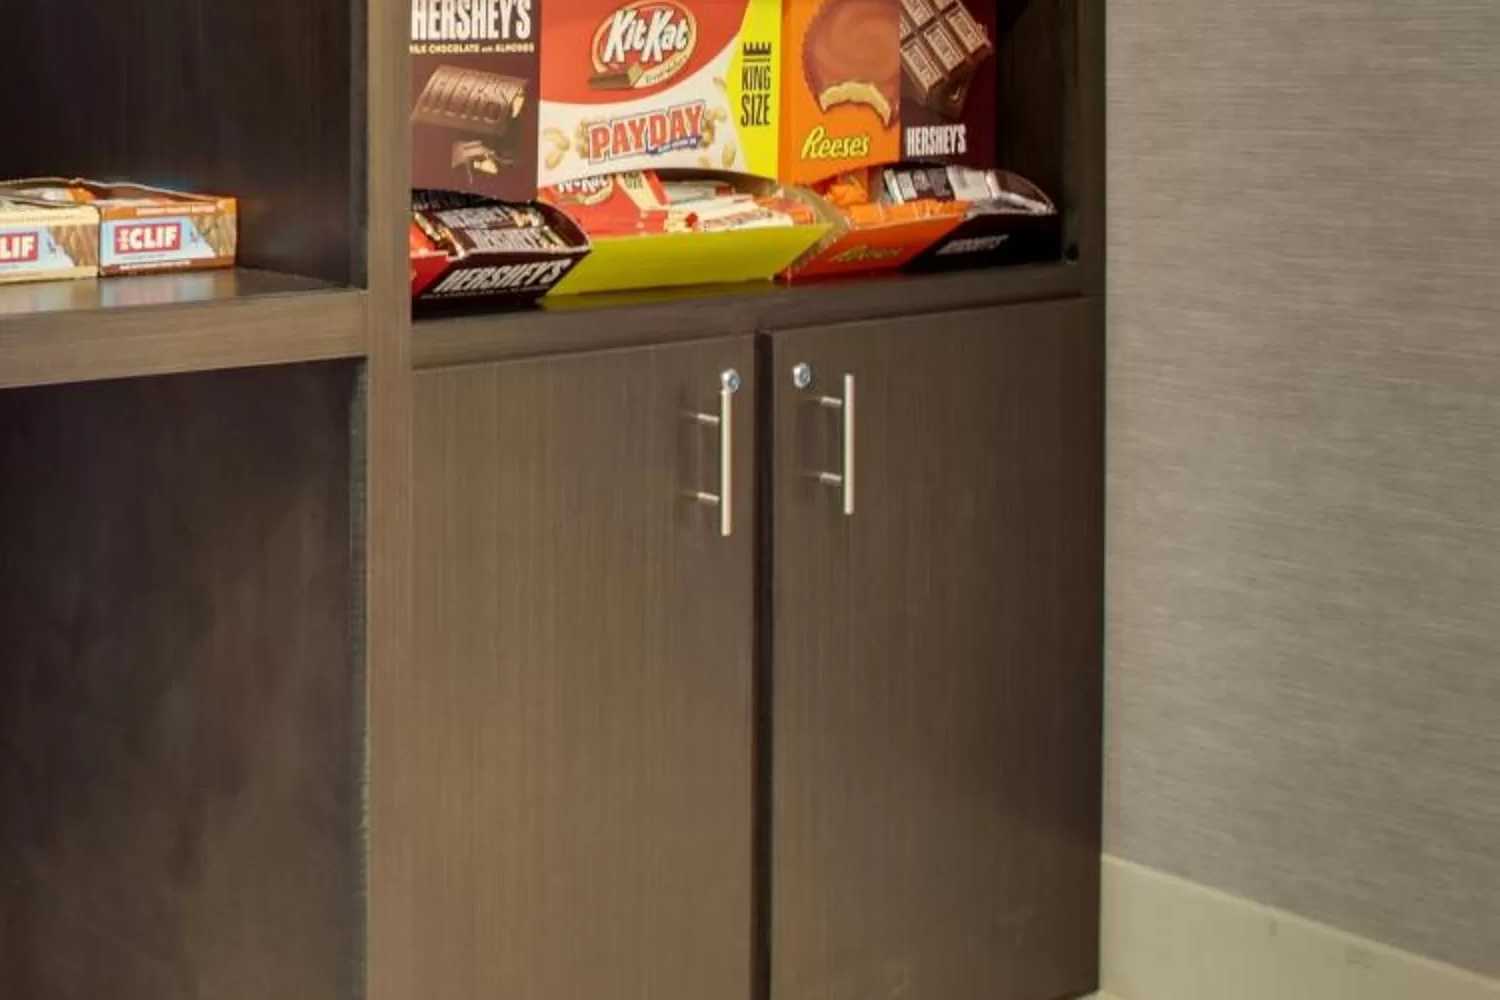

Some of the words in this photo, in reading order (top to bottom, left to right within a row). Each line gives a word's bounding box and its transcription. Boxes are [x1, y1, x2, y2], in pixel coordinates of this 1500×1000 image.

[741, 66, 771, 91] KING
[740, 94, 771, 127] SIZE
[590, 104, 704, 160] PAYDAY
[906, 124, 967, 157] HERSHEY'S
[129, 223, 178, 250] CLIF
[431, 258, 577, 293] HERSHEY'S
